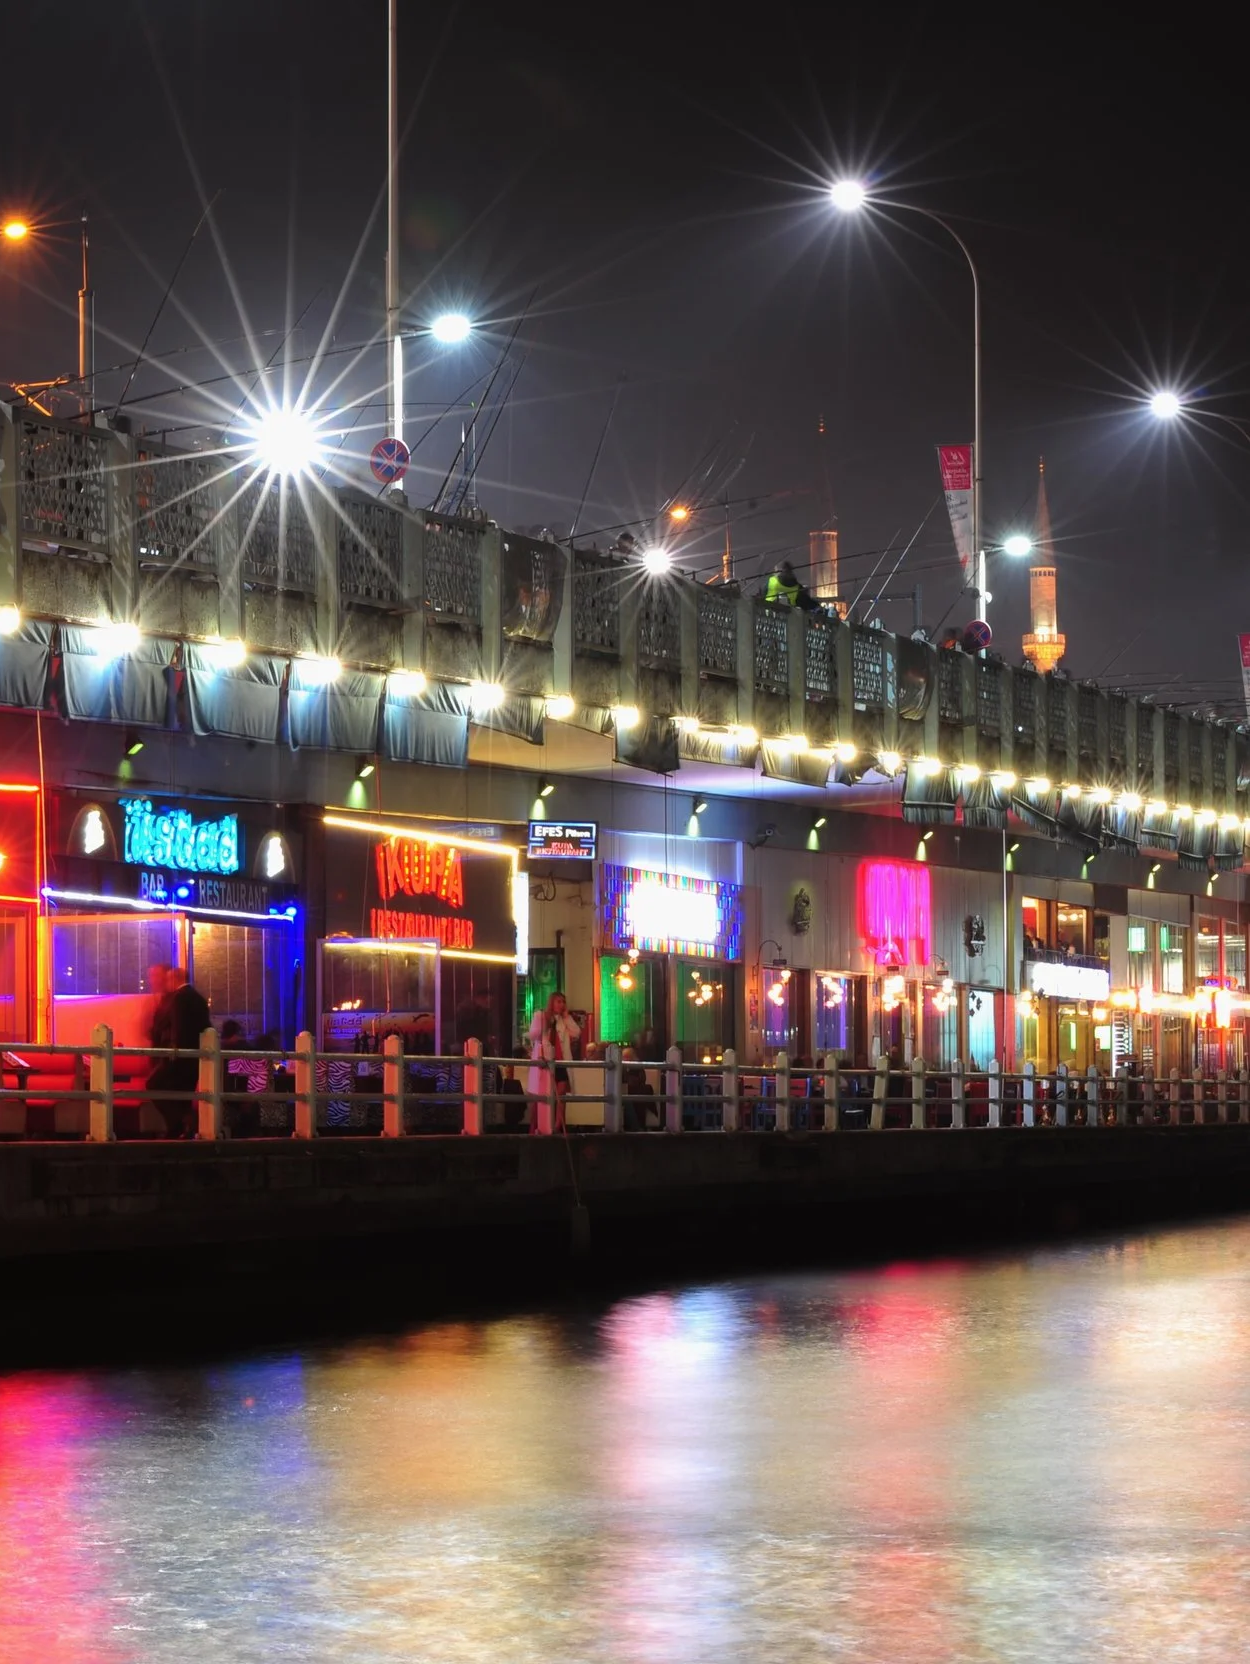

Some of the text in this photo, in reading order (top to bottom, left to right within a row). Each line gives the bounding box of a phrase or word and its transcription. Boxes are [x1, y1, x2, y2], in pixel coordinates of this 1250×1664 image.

[534, 825, 563, 837] EFES
[141, 872, 268, 912] BAR RESTAURANT
